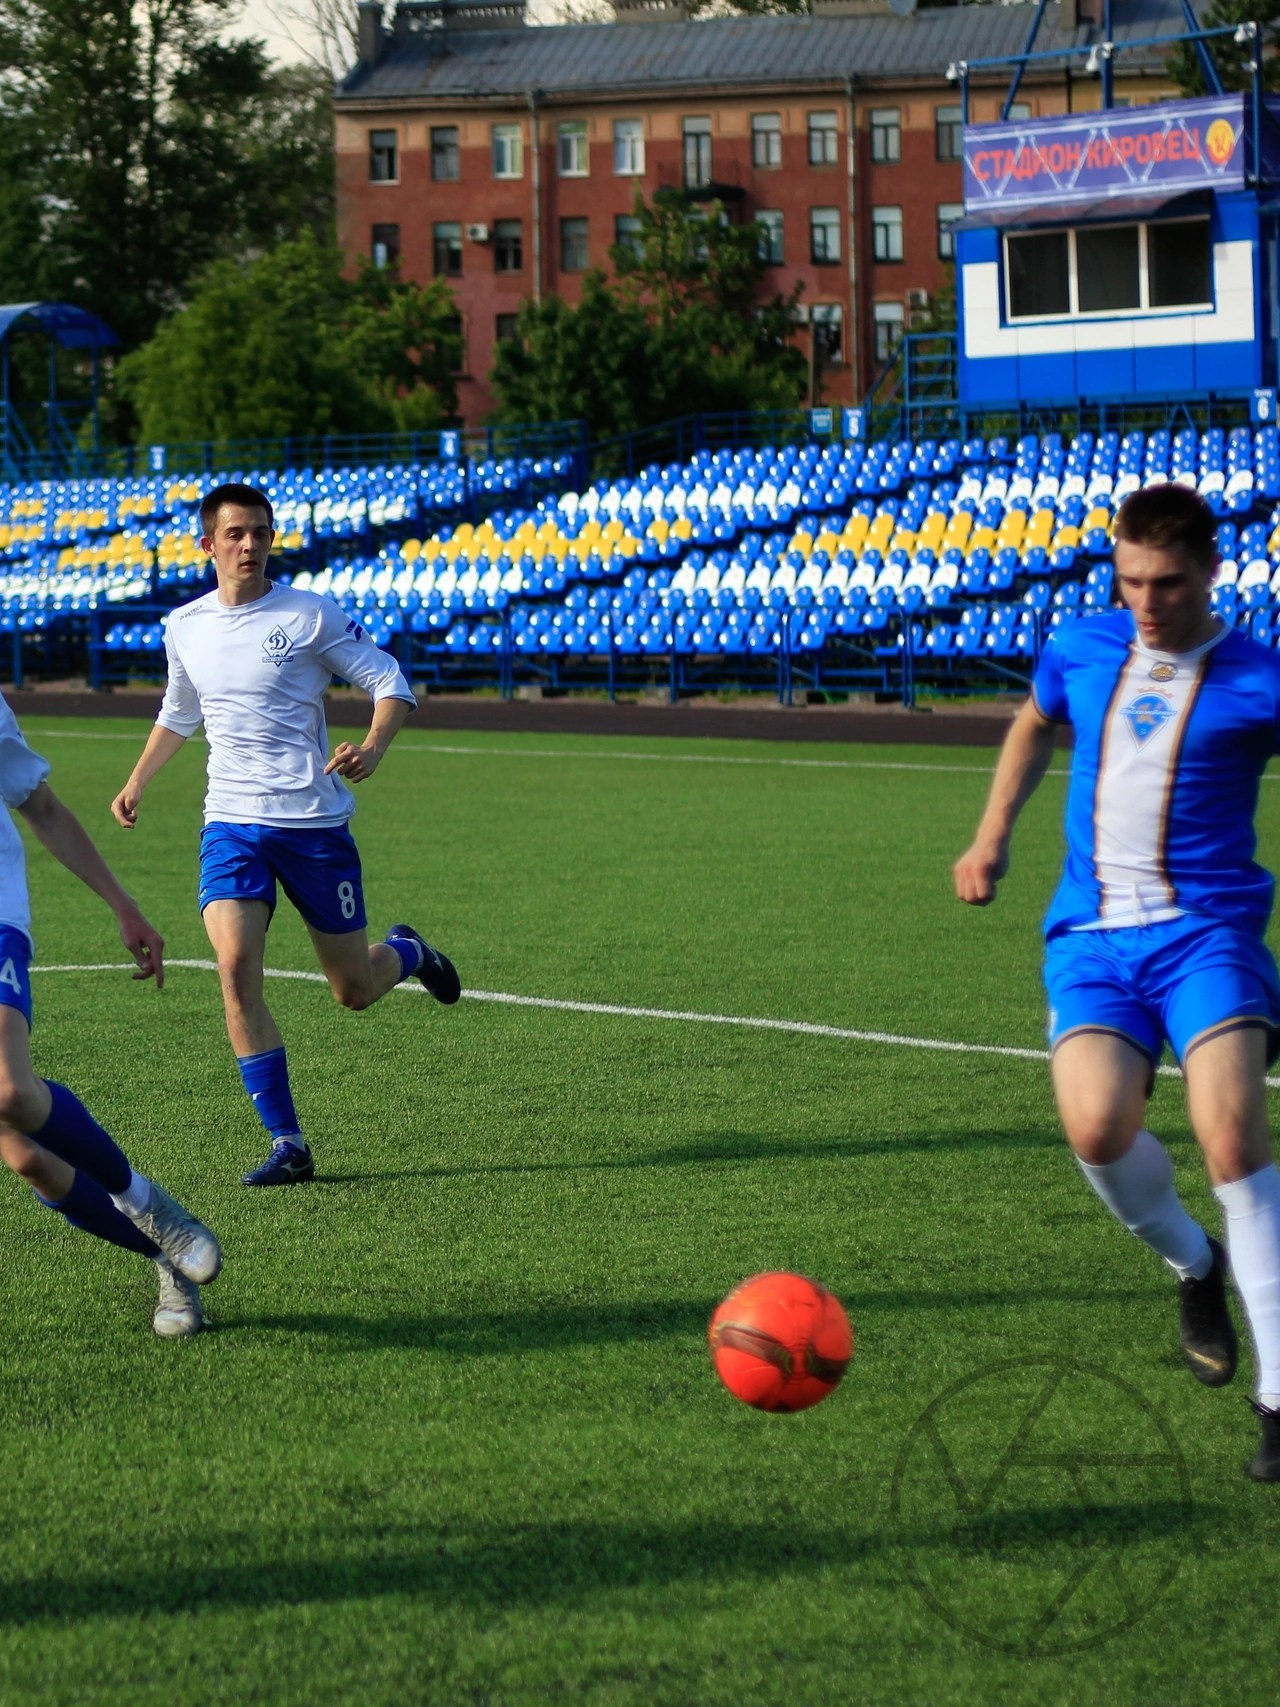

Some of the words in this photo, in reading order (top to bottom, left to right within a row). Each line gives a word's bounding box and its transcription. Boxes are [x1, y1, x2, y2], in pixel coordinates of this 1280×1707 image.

[973, 142, 1081, 181] СТАДИОН
[1086, 127, 1200, 169] КИРОВЕЦ
[337, 881, 356, 919] 8
